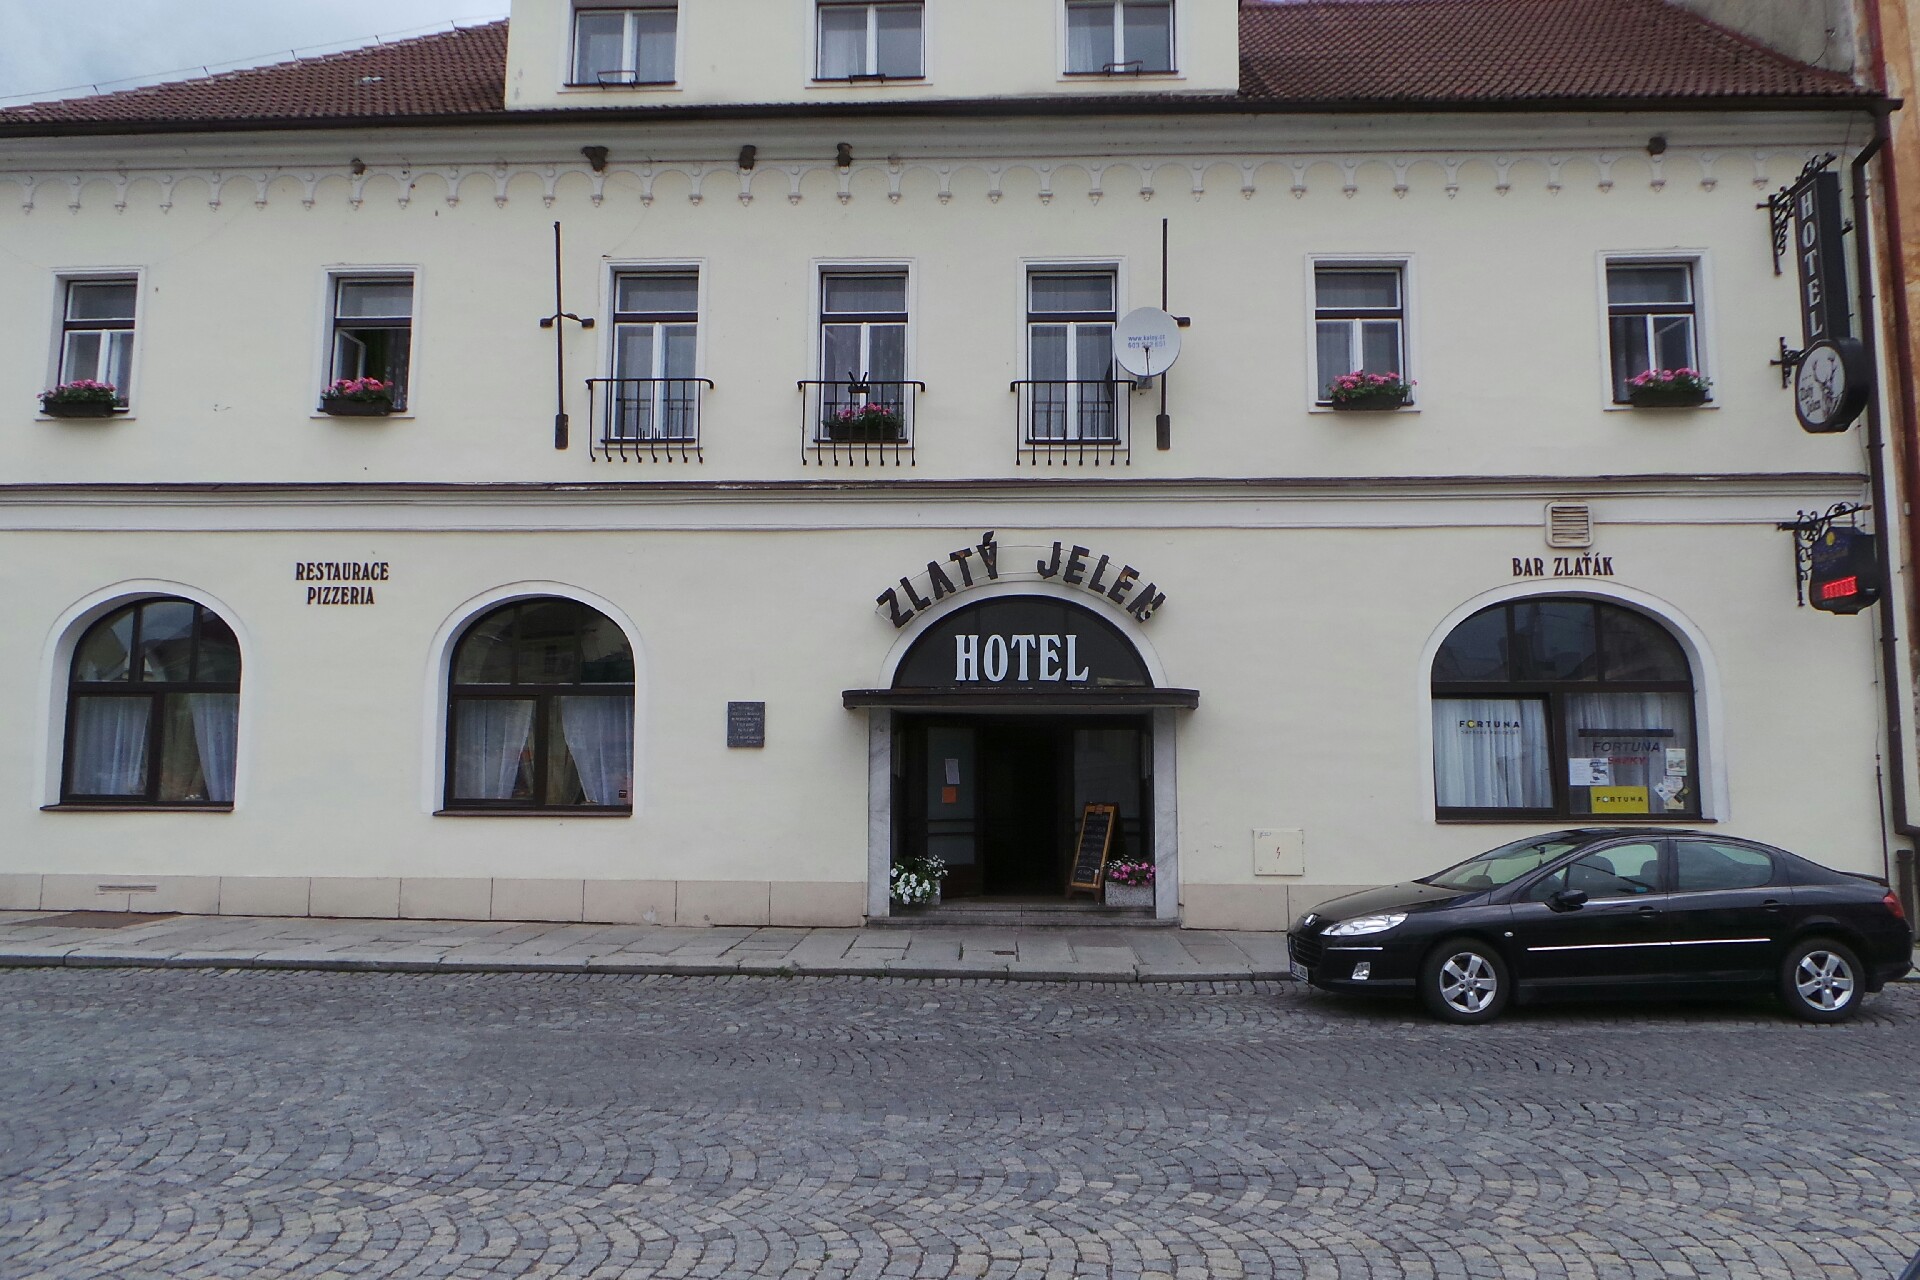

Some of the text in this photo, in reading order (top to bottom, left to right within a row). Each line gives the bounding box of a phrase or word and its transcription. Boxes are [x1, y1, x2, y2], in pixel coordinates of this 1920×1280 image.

[1801, 189, 1823, 337] HOTEL
[295, 562, 390, 581] RESTAURACE
[1512, 552, 1614, 576] BAR ZLAŤÁK
[876, 530, 1167, 628] ZLATÝ JELEN
[307, 586, 375, 605] PIZZERIA
[955, 634, 1089, 682] HOTEL
[1459, 719, 1520, 728] FORTUNA
[1593, 741, 1660, 752] FORTUNA
